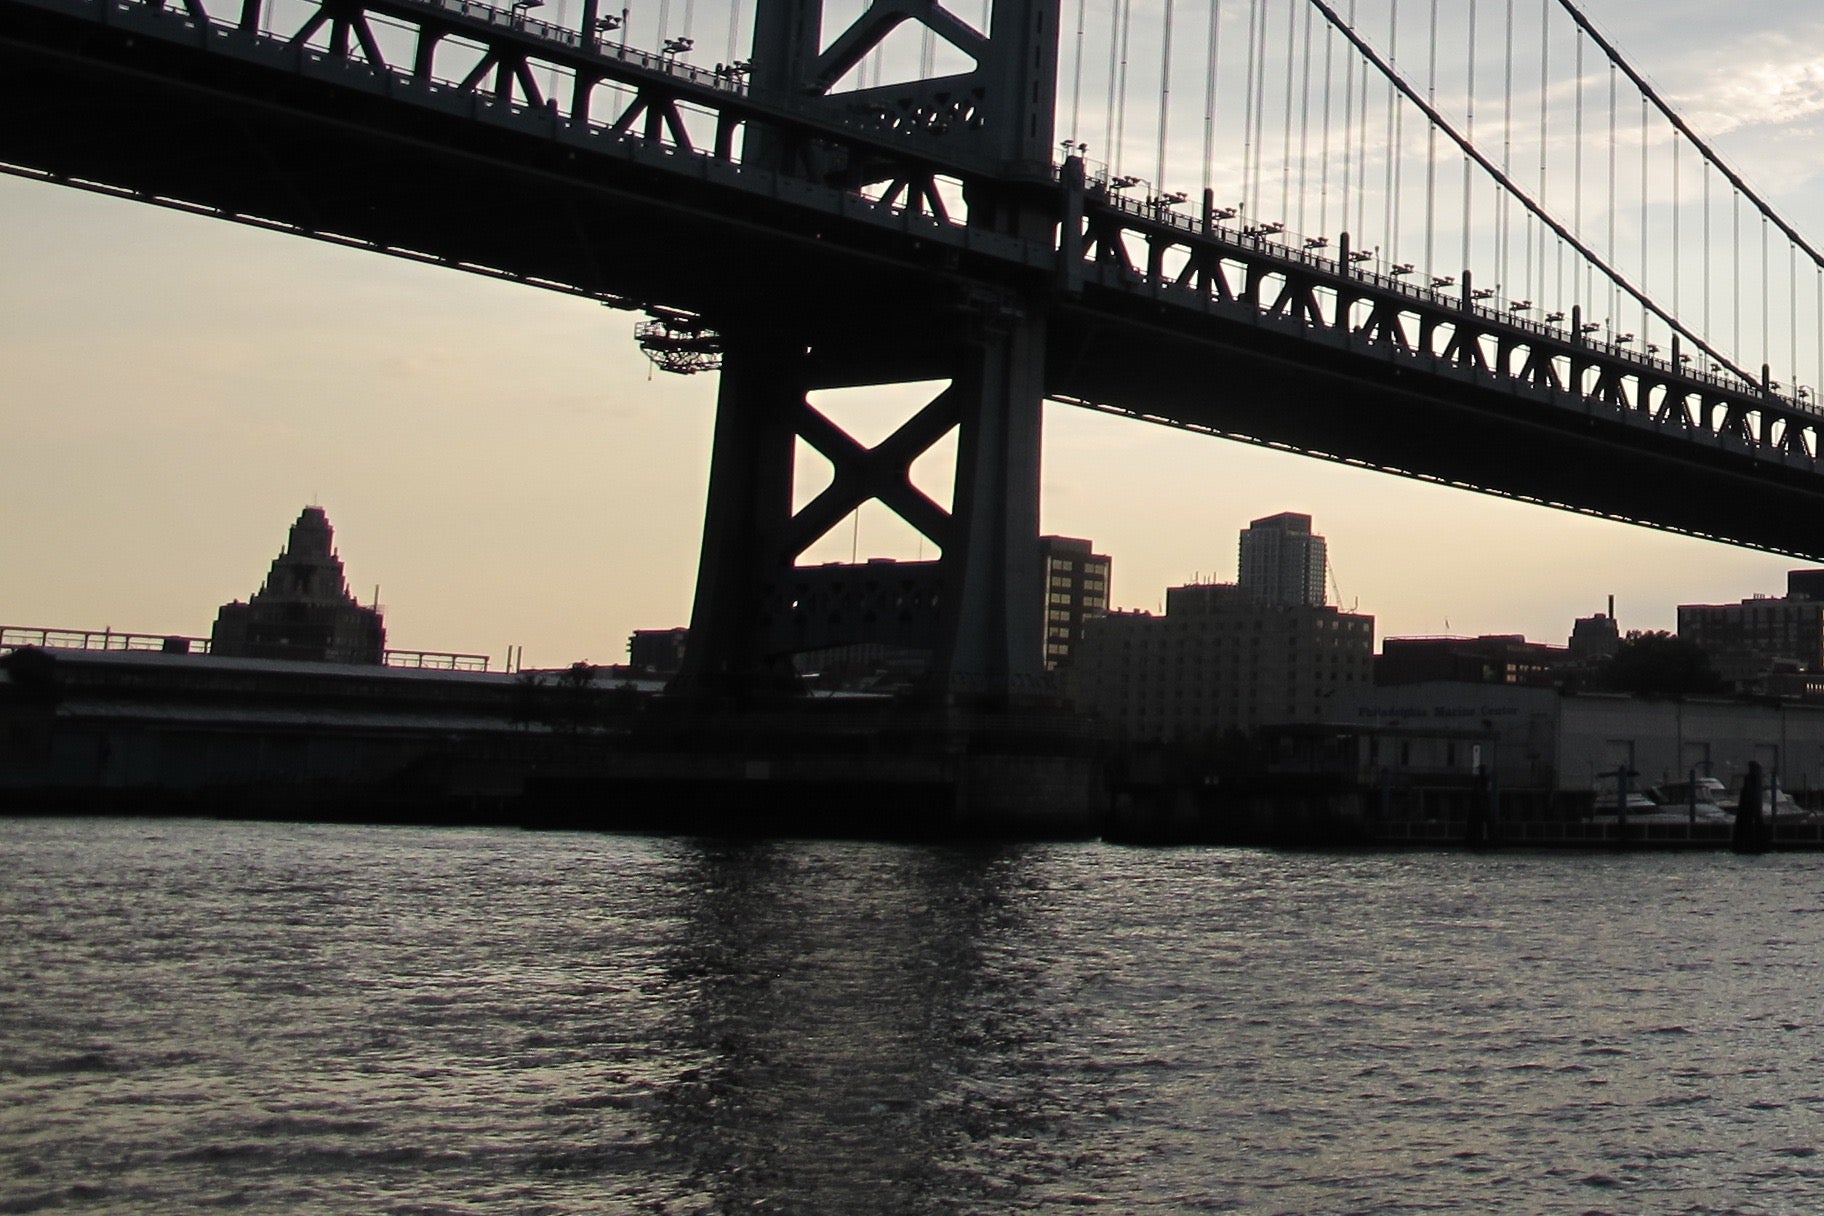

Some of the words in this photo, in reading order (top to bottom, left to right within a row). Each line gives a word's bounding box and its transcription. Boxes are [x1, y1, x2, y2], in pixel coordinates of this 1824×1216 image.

[1358, 706, 1427, 718] Philadelphia
[1434, 706, 1475, 717] Marine
[1480, 705, 1518, 716] Center
